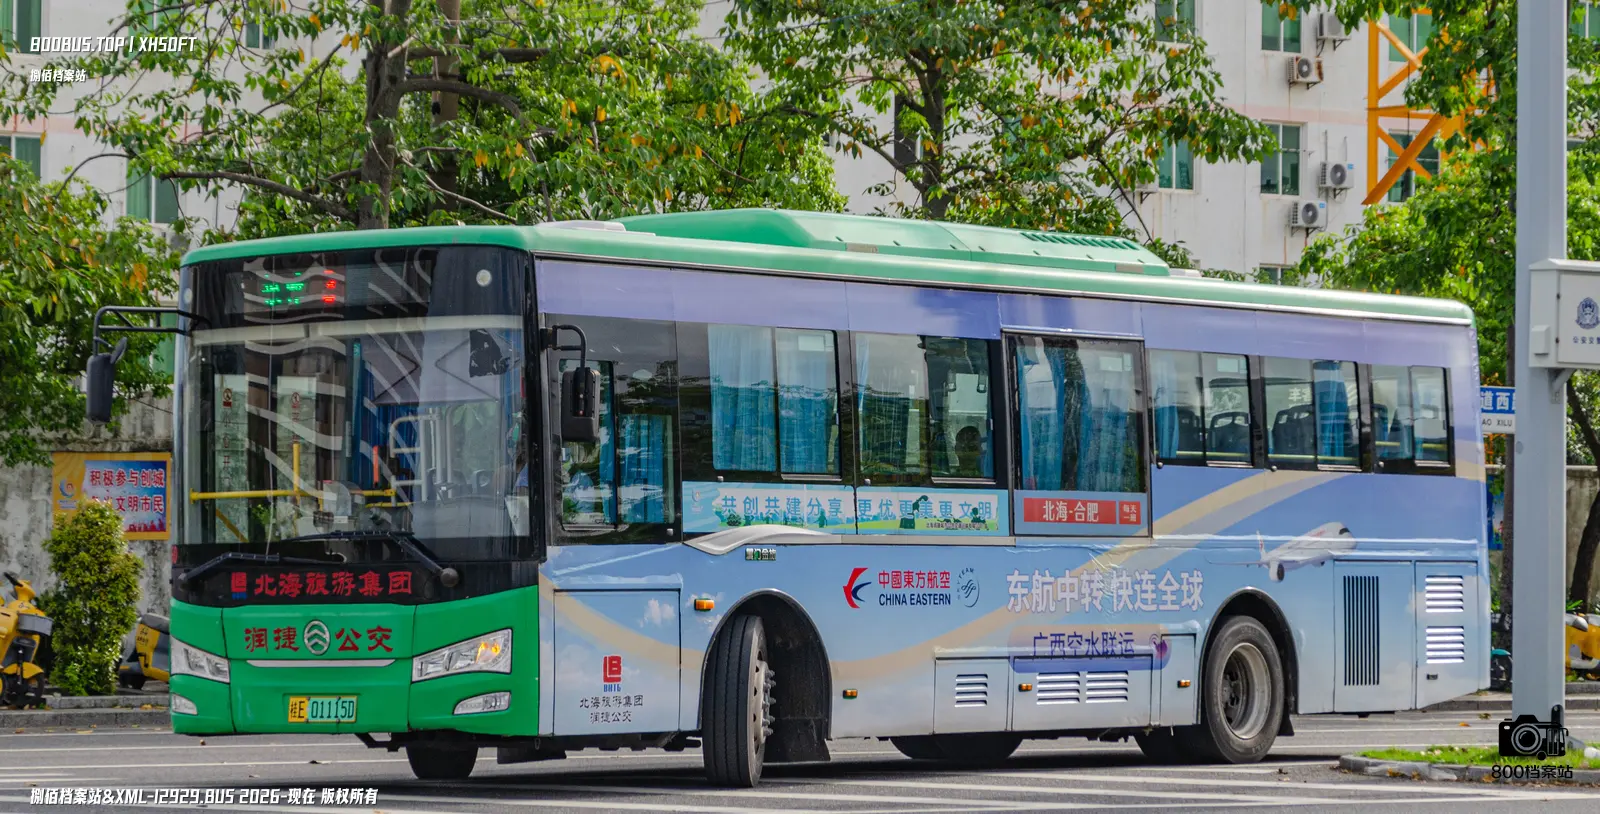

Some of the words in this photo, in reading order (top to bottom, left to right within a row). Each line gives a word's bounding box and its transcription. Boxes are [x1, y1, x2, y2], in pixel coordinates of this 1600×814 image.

[1481, 391, 1516, 410] 道西
[90, 469, 165, 487] 积极参与创城
[91, 496, 164, 512] 文明市民
[721, 495, 843, 517] 共创共建分享
[858, 499, 992, 519] 更优更美更文明
[1042, 500, 1099, 522] 北海-合肥
[254, 571, 413, 597] 北海旅游集团
[878, 570, 951, 589] 中國東方航空
[879, 593, 907, 606] CHINA
[910, 593, 951, 606] EASTERN
[1006, 568, 1103, 613] 东航中转
[1111, 569, 1205, 612] 快连全球
[335, 625, 393, 653] 公交
[1033, 631, 1135, 660] 广西空水联运
[580, 695, 644, 709] 北海旅游集团
